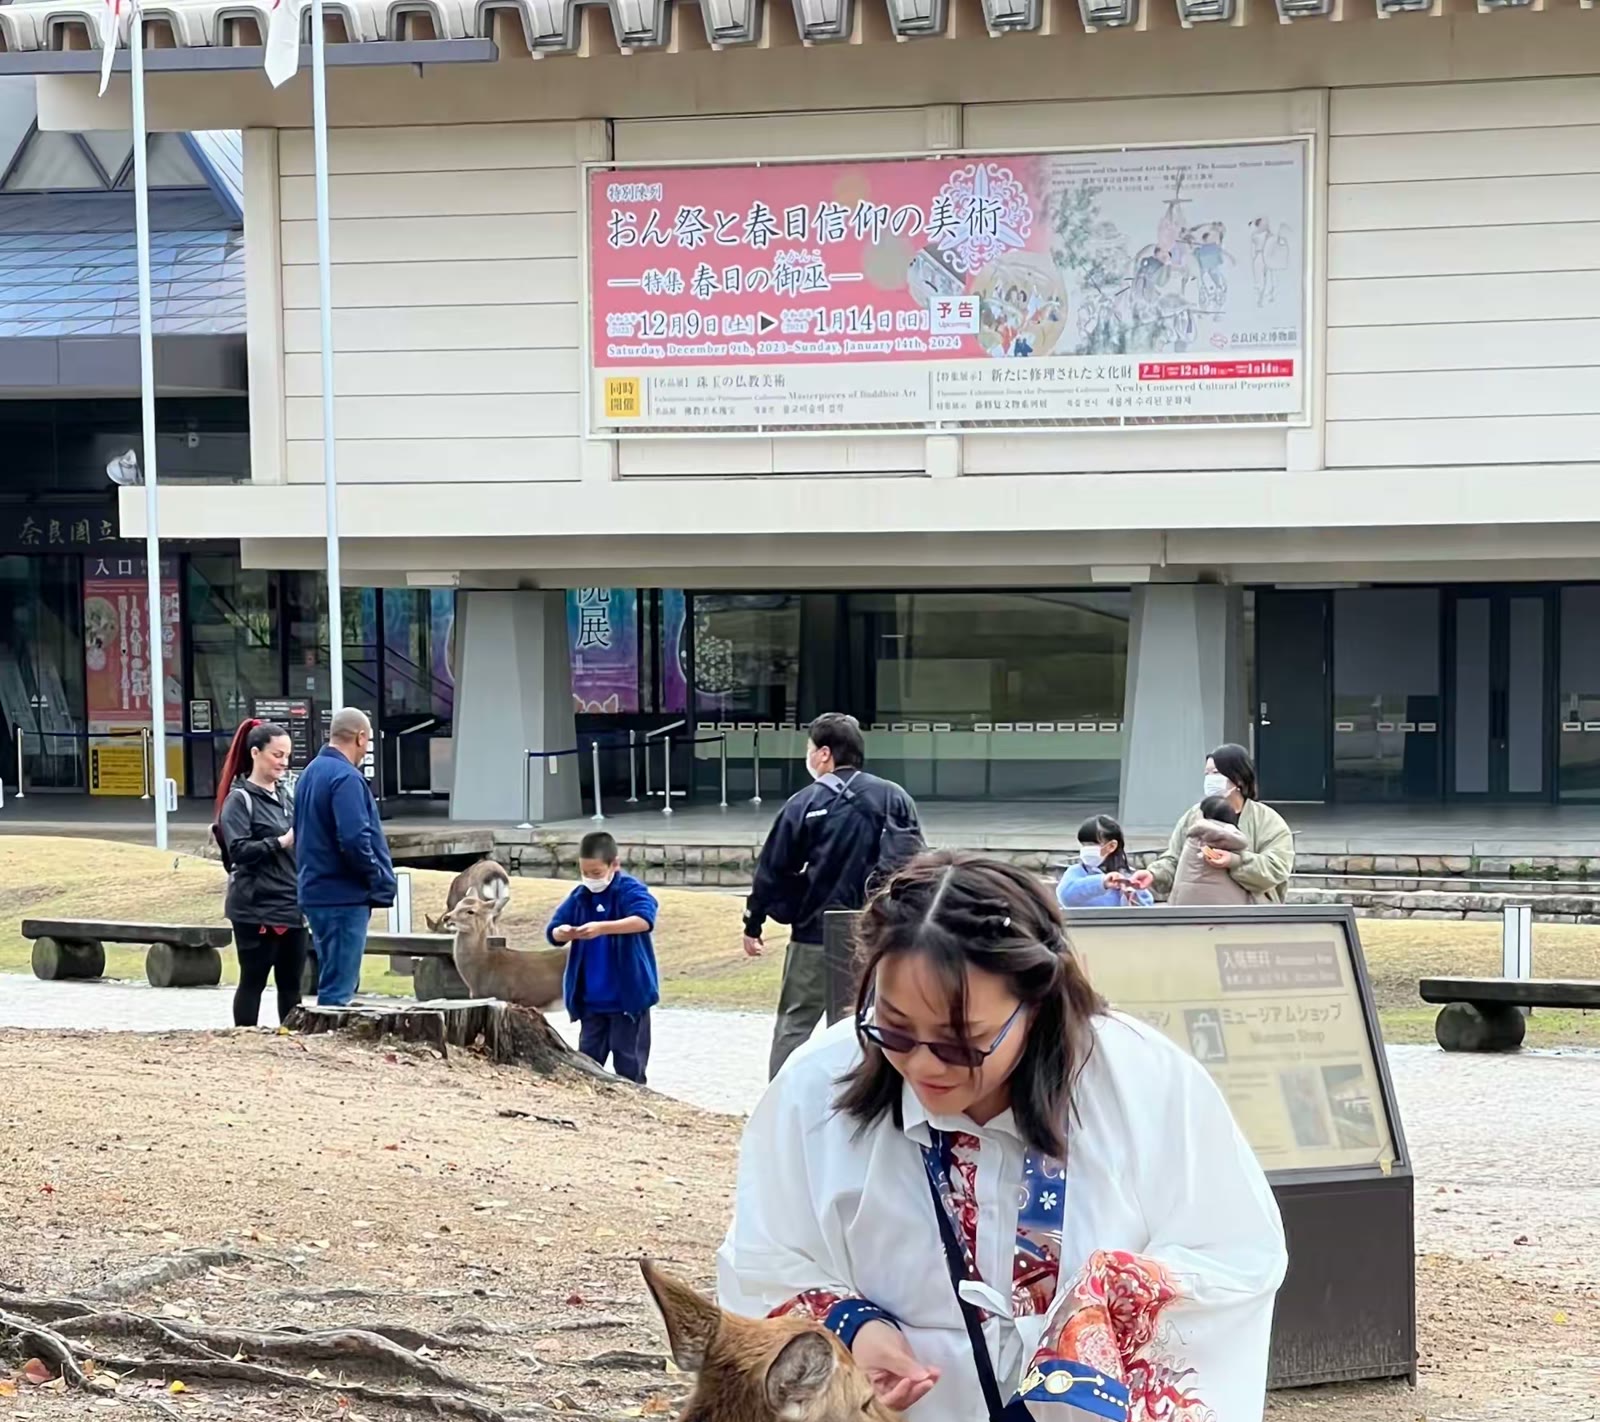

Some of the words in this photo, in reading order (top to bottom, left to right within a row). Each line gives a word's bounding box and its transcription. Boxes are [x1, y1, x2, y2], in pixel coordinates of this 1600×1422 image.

[608, 183, 663, 201] 特別陳列
[608, 196, 1002, 248] おん祭と春日信仰の美術
[775, 249, 822, 264] みかんこ
[937, 301, 975, 320] 予告
[609, 345, 664, 358] Saturday,
[669, 343, 727, 355] December
[845, 338, 892, 353] January
[931, 337, 961, 349] 2024
[991, 365, 1132, 382] 新たに修理された文化財
[610, 382, 634, 396] 同時
[903, 387, 917, 398] Art
[1116, 382, 1143, 393] Newly
[1147, 380, 1196, 392] Conserved
[1199, 379, 1238, 392] Cultural
[1241, 378, 1291, 392] Properties
[95, 559, 132, 575] 入口
[1222, 1002, 1342, 1025] ミュージアムショップ
